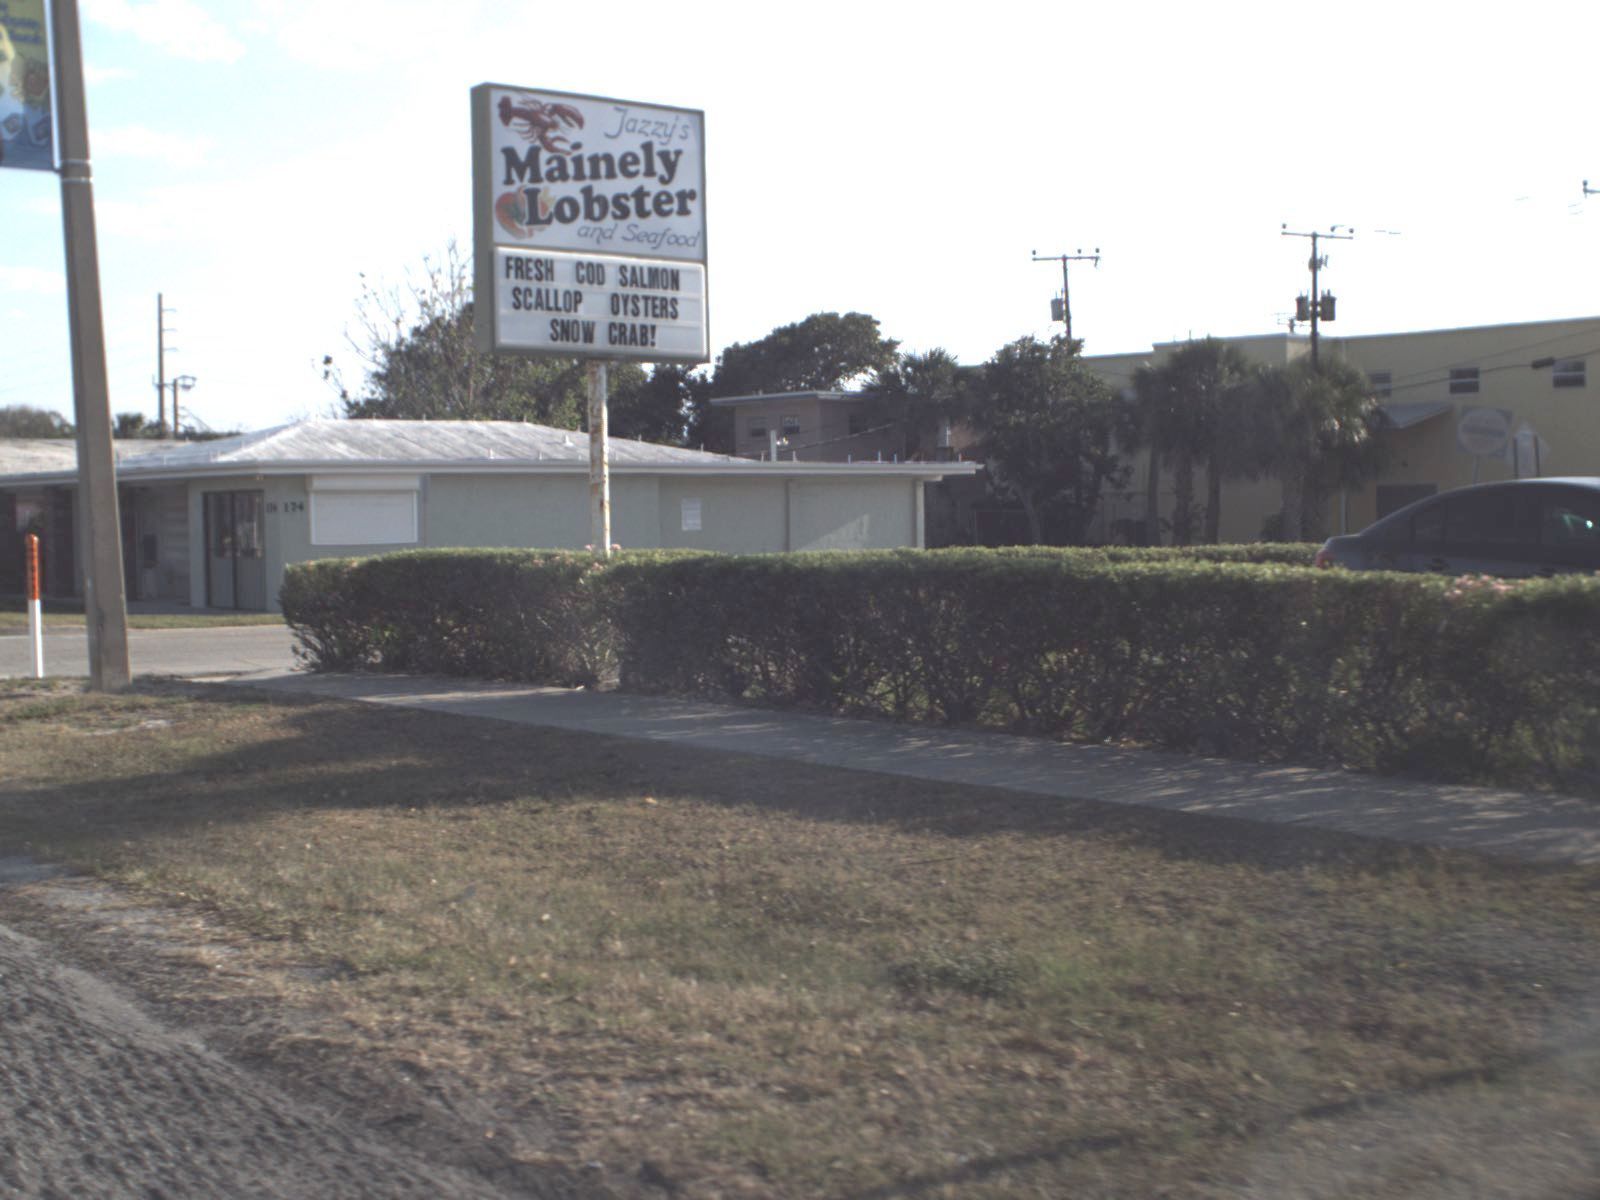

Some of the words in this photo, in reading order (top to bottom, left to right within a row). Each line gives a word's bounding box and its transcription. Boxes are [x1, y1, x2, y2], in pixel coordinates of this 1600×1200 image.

[604, 106, 690, 146] Jazzy's
[501, 140, 683, 185] Mainely
[523, 185, 697, 226] Lobster
[577, 223, 617, 244] and
[622, 224, 700, 251] Seafood
[505, 256, 555, 282] FRESH
[575, 260, 605, 286] COD
[619, 264, 680, 291] SALMON
[512, 286, 583, 313] SCALLOP
[610, 292, 679, 320] OYSTERS
[550, 318, 596, 344] SNOW
[608, 322, 657, 347] CRAB!
